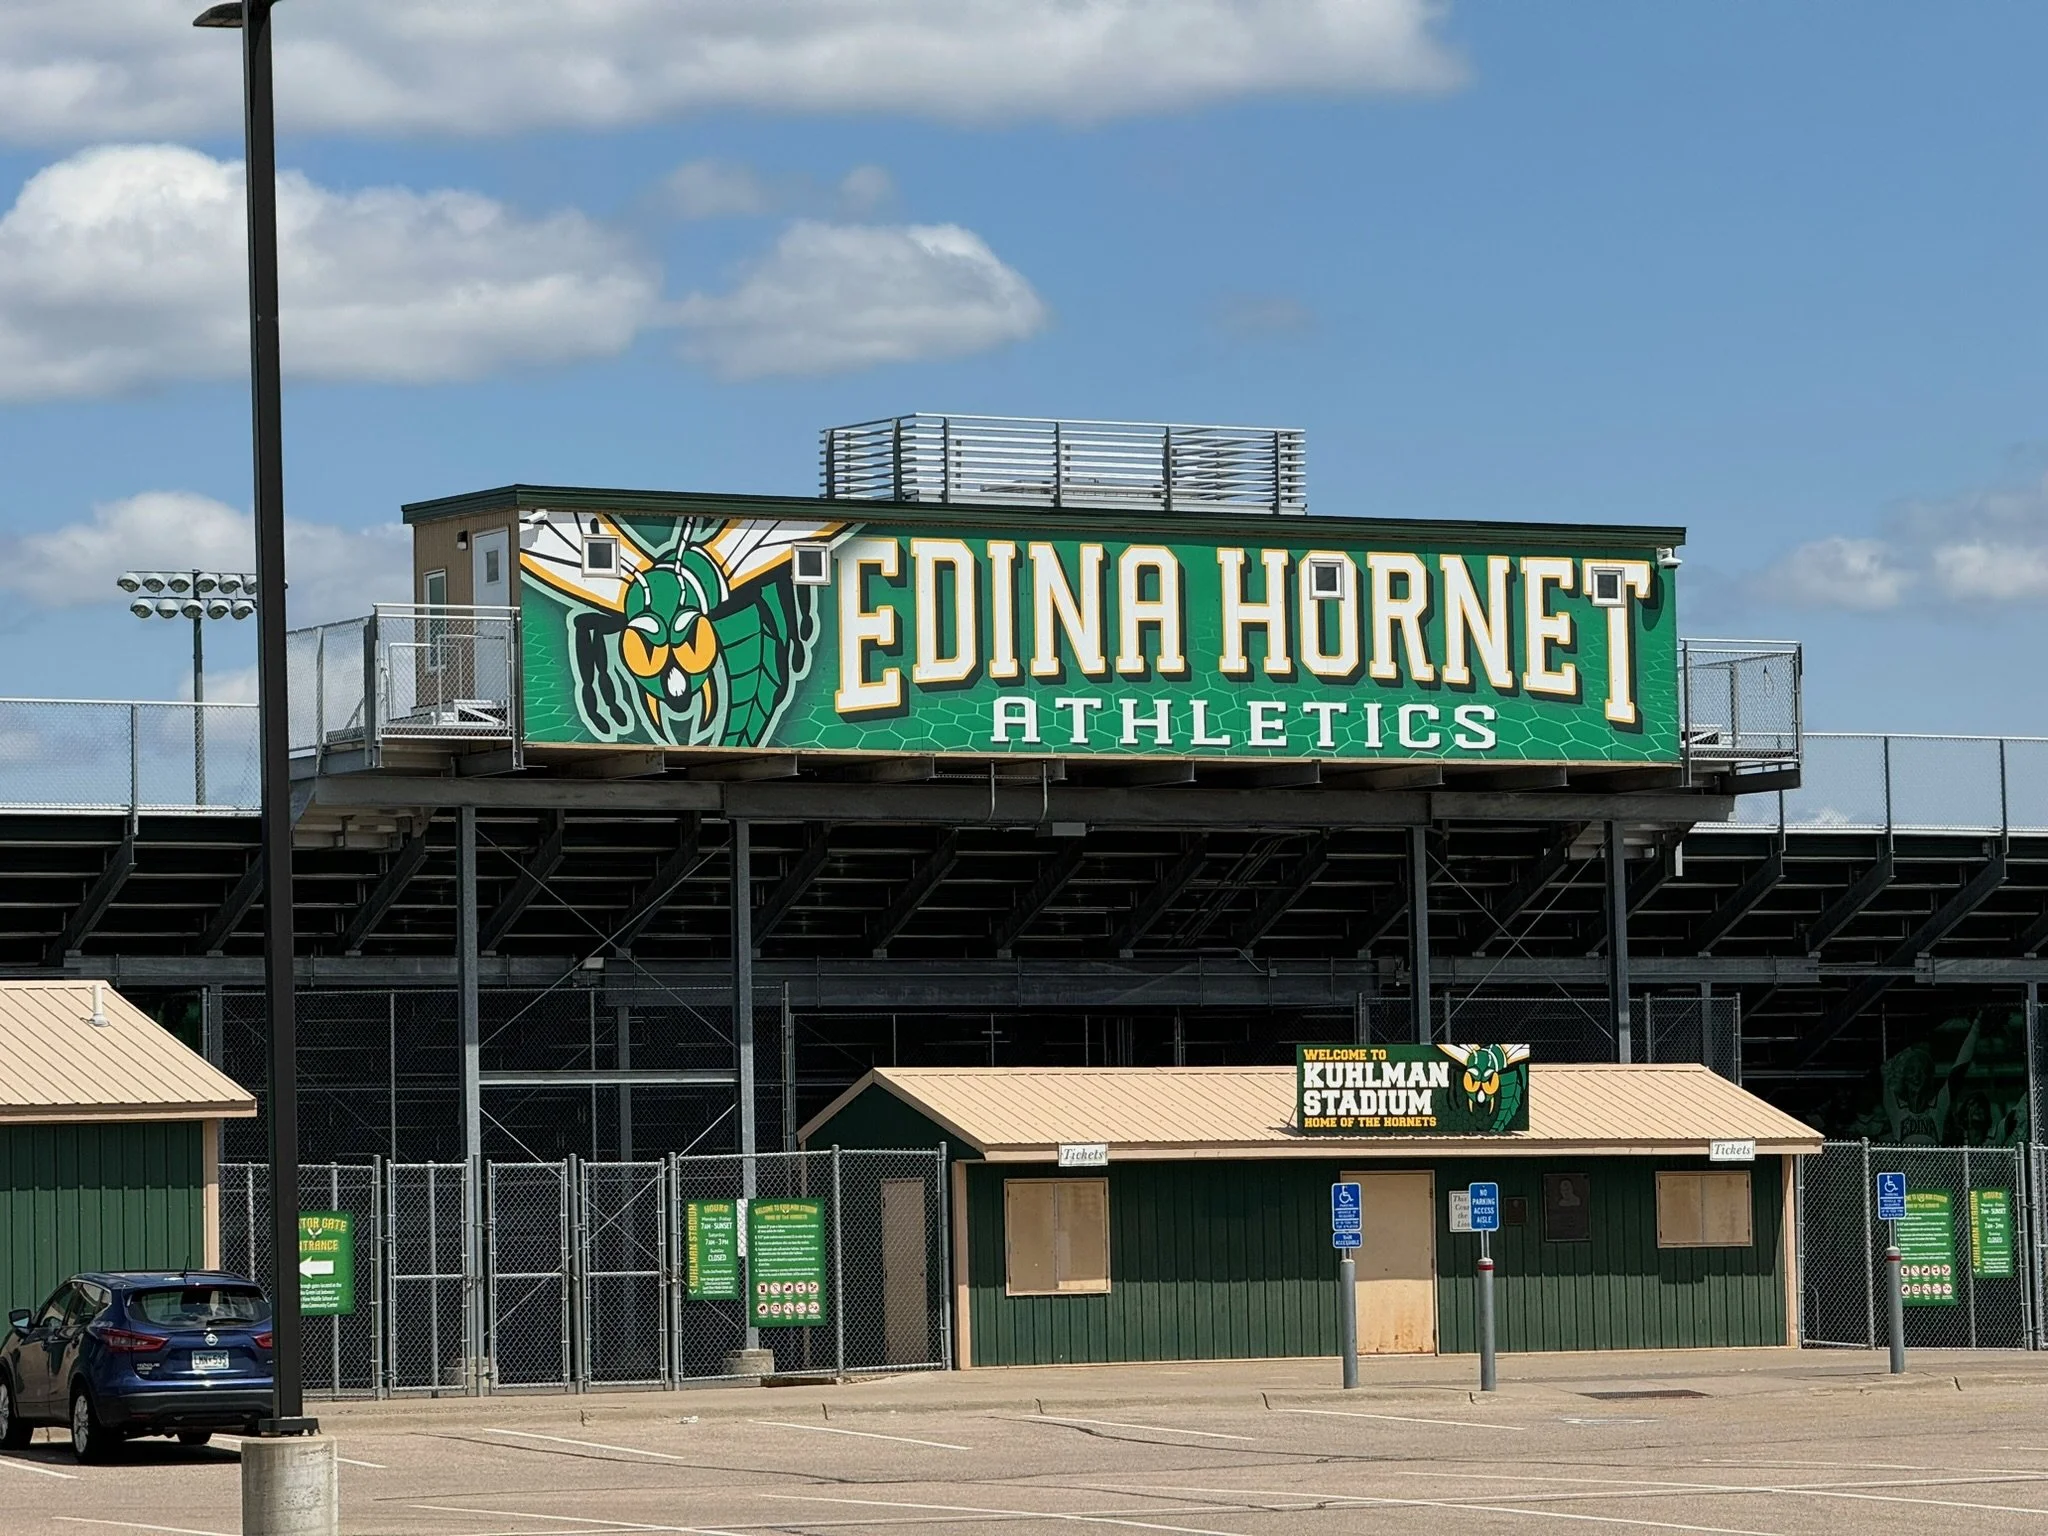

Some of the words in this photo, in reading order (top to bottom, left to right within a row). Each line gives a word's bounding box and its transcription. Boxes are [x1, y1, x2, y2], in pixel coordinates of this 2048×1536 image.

[834, 536, 1186, 713] EDINA
[1217, 547, 1650, 724] HORNET
[991, 696, 1497, 751] ATHLETICS
[1303, 1049, 1367, 1061] WELCOME
[1370, 1049, 1387, 1061] TO
[1303, 1061, 1450, 1088] KUHLMAN
[1303, 1089, 1433, 1116] STADIUM
[1304, 1117, 1339, 1128] HOME
[1340, 1117, 1356, 1128] OF
[1357, 1117, 1382, 1128] THE
[1383, 1116, 1437, 1128] HORNETS
[1063, 1148, 1104, 1161] Tickets
[1714, 1143, 1751, 1155] Tickets
[703, 1204, 729, 1214] HOURS
[1472, 1198, 1496, 1206] PARKING
[1970, 1190, 1979, 1226] STADIUM
[1473, 1206, 1495, 1215] ACCESS
[299, 1217, 320, 1229] TOR
[321, 1217, 348, 1233] GATE
[688, 1203, 698, 1242] STADIUM
[1476, 1215, 1492, 1224] AISLE
[1972, 1227, 1981, 1267] KUHLMAN
[708, 1254, 727, 1262] CLOSED
[689, 1245, 699, 1287] KUHLMAN
